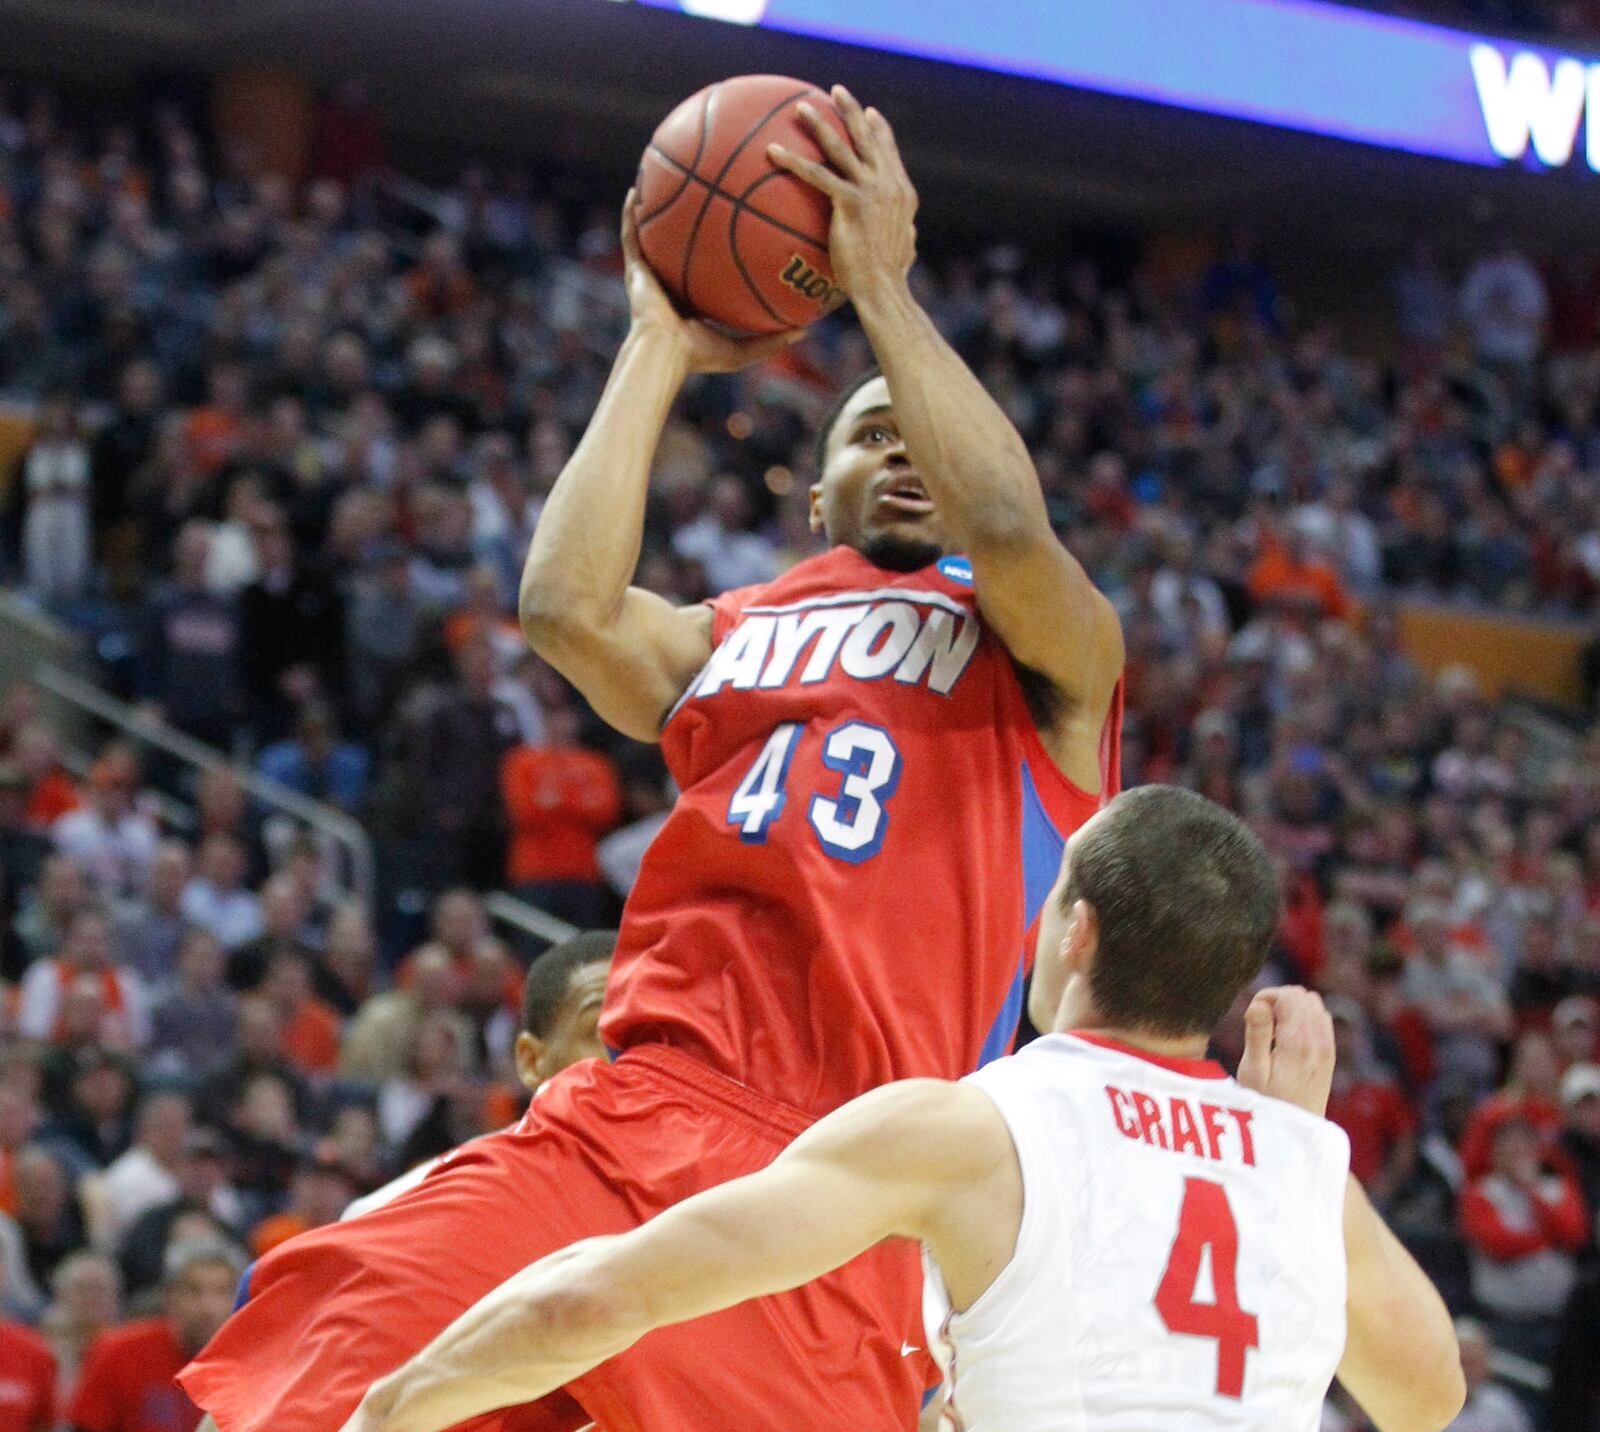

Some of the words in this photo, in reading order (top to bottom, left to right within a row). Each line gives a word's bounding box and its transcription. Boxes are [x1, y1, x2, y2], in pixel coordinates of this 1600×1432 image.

[695, 602, 980, 698] AYTON
[726, 719, 904, 865] 43
[1104, 1084, 1258, 1167] CRAFT
[1151, 1175, 1260, 1401] 4
